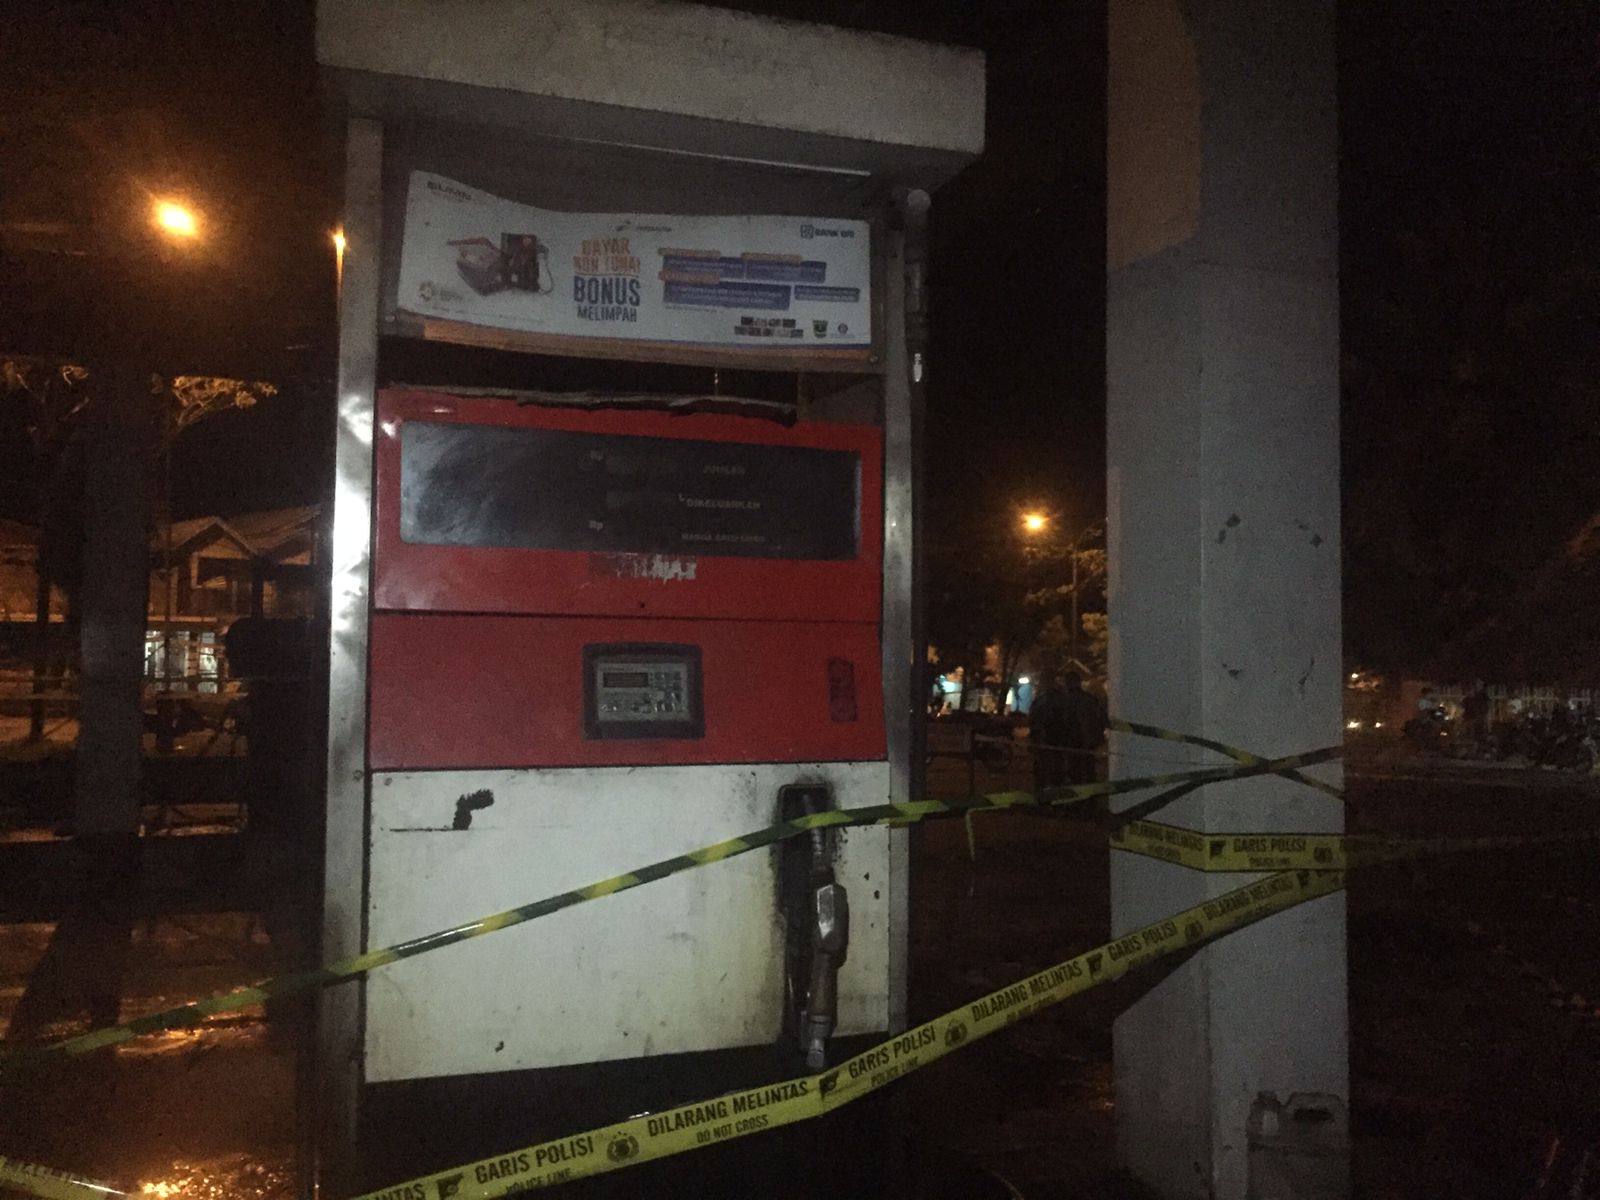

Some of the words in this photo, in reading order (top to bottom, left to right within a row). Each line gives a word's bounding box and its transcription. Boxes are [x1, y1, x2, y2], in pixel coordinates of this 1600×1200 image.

[582, 238, 631, 256] BAYAR
[573, 255, 599, 273] NON
[573, 275, 641, 306] BONUS
[577, 305, 638, 323] MELIMPAH
[1233, 838, 1268, 853] GARIS
[1108, 935, 1142, 961] GARIS
[1142, 921, 1177, 946] POLISI
[971, 984, 1028, 1022] DILARANG
[1029, 960, 1083, 996] MELINTAS
[849, 1046, 890, 1079] GARIS
[893, 1026, 936, 1058] POLISI
[647, 1101, 728, 1137] DILARANG
[733, 1080, 810, 1114] MELINTAS
[696, 1130, 711, 1143] DO
[713, 1122, 733, 1138] NOT
[735, 1114, 769, 1133] CROSS
[475, 1153, 530, 1184] GARIS
[535, 1136, 594, 1168] POLISI
